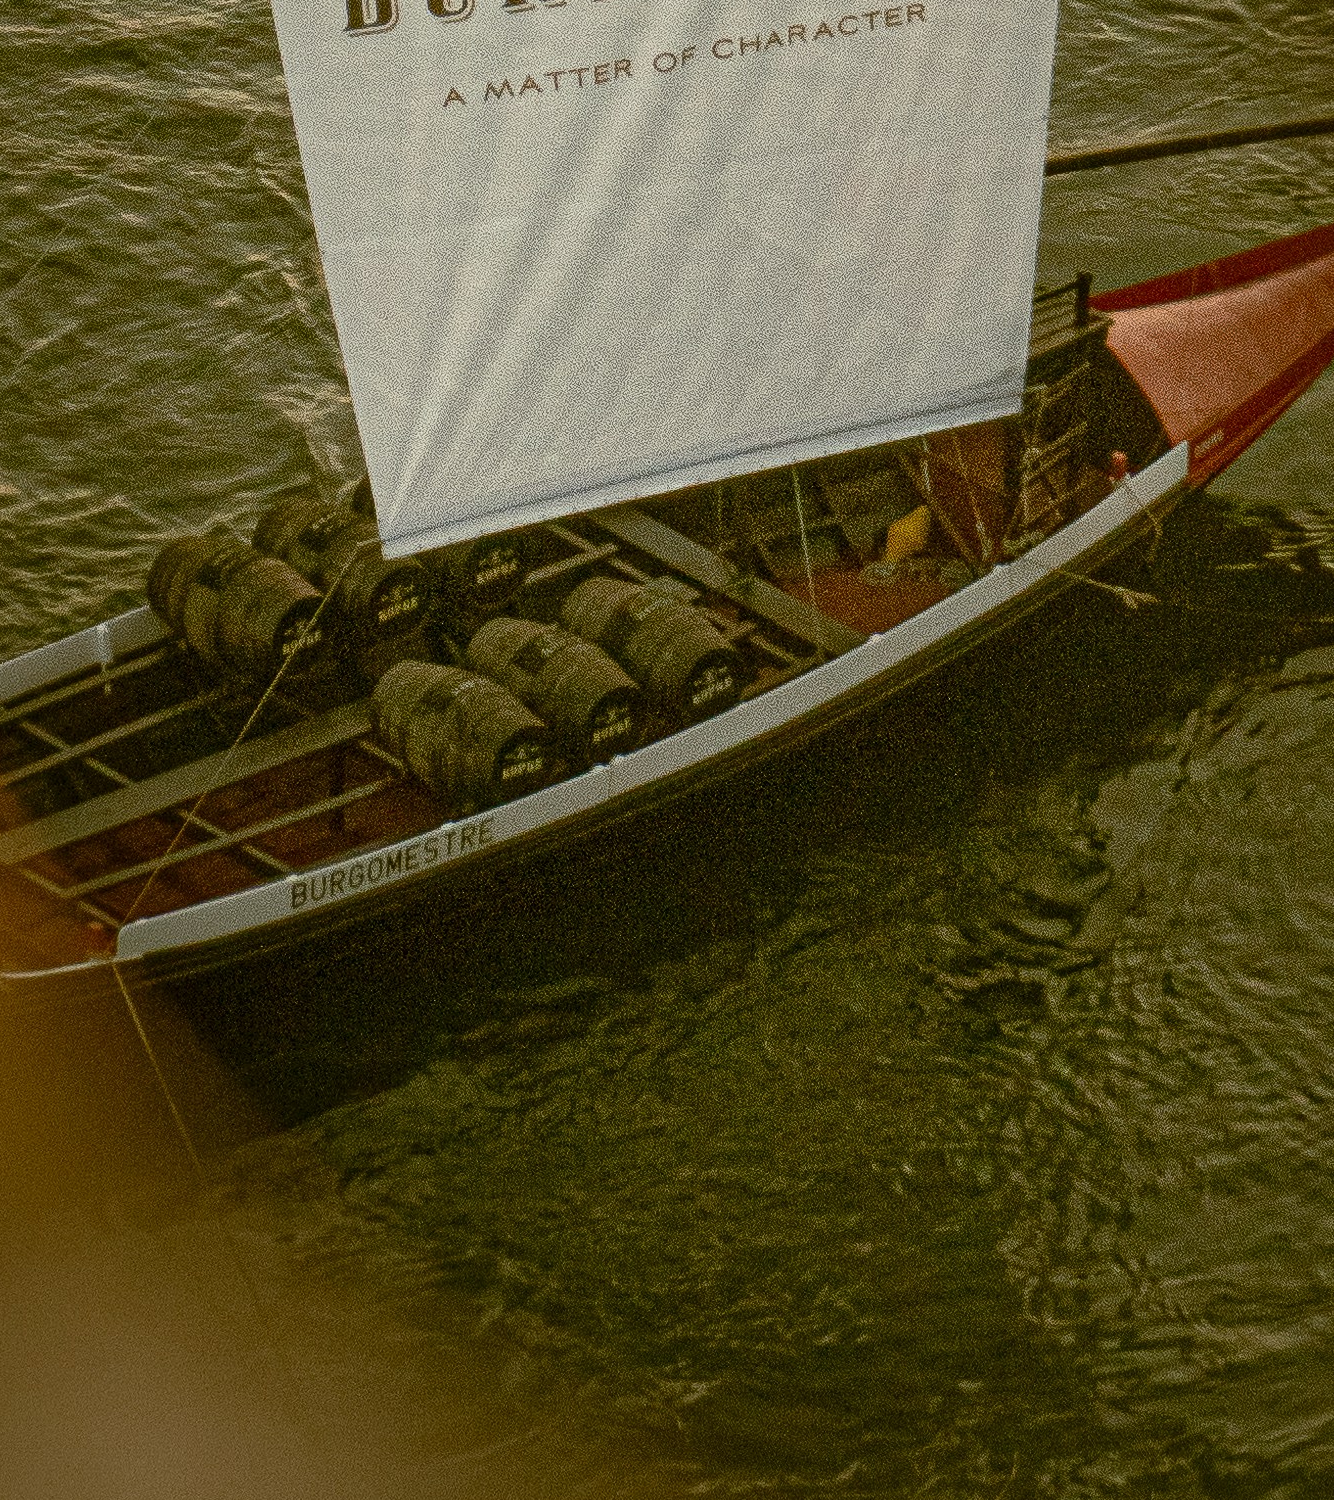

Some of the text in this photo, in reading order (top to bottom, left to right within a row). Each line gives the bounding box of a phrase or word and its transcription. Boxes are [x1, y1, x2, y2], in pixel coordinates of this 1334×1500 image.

[442, 3, 927, 108] A MATTER OF CHARACTER
[290, 817, 495, 909] BURGOMESTRE
